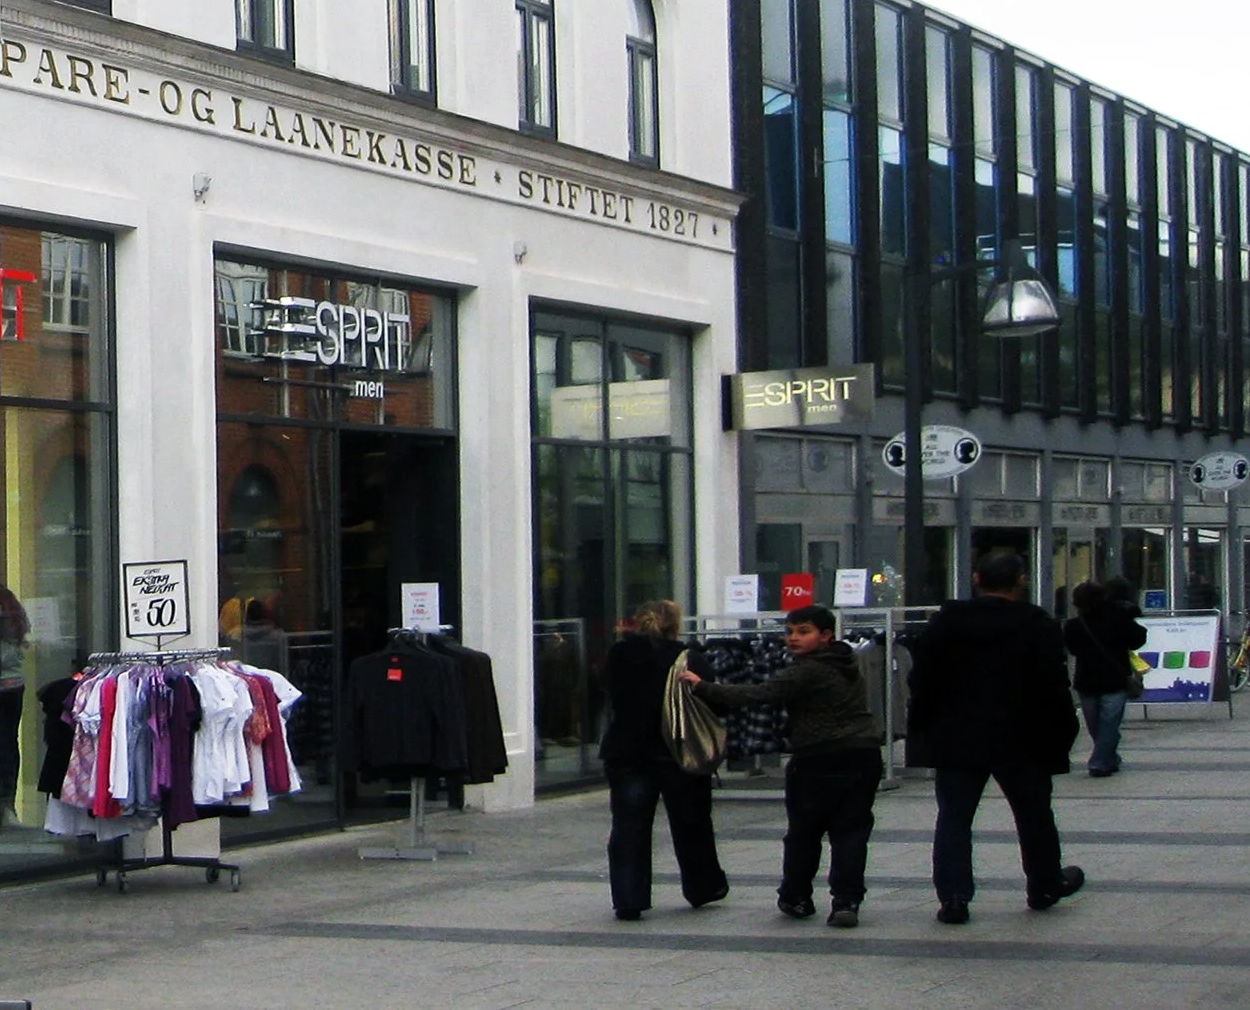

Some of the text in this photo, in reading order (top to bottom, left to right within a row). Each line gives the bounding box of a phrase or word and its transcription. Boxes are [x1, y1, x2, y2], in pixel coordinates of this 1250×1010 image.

[233, 96, 477, 186] LAANEKASSE
[518, 171, 636, 224] STIFTET
[647, 202, 700, 239] 1827
[280, 296, 411, 371] ESPRIT
[354, 378, 384, 398] men
[745, 377, 857, 407] ESPRIT
